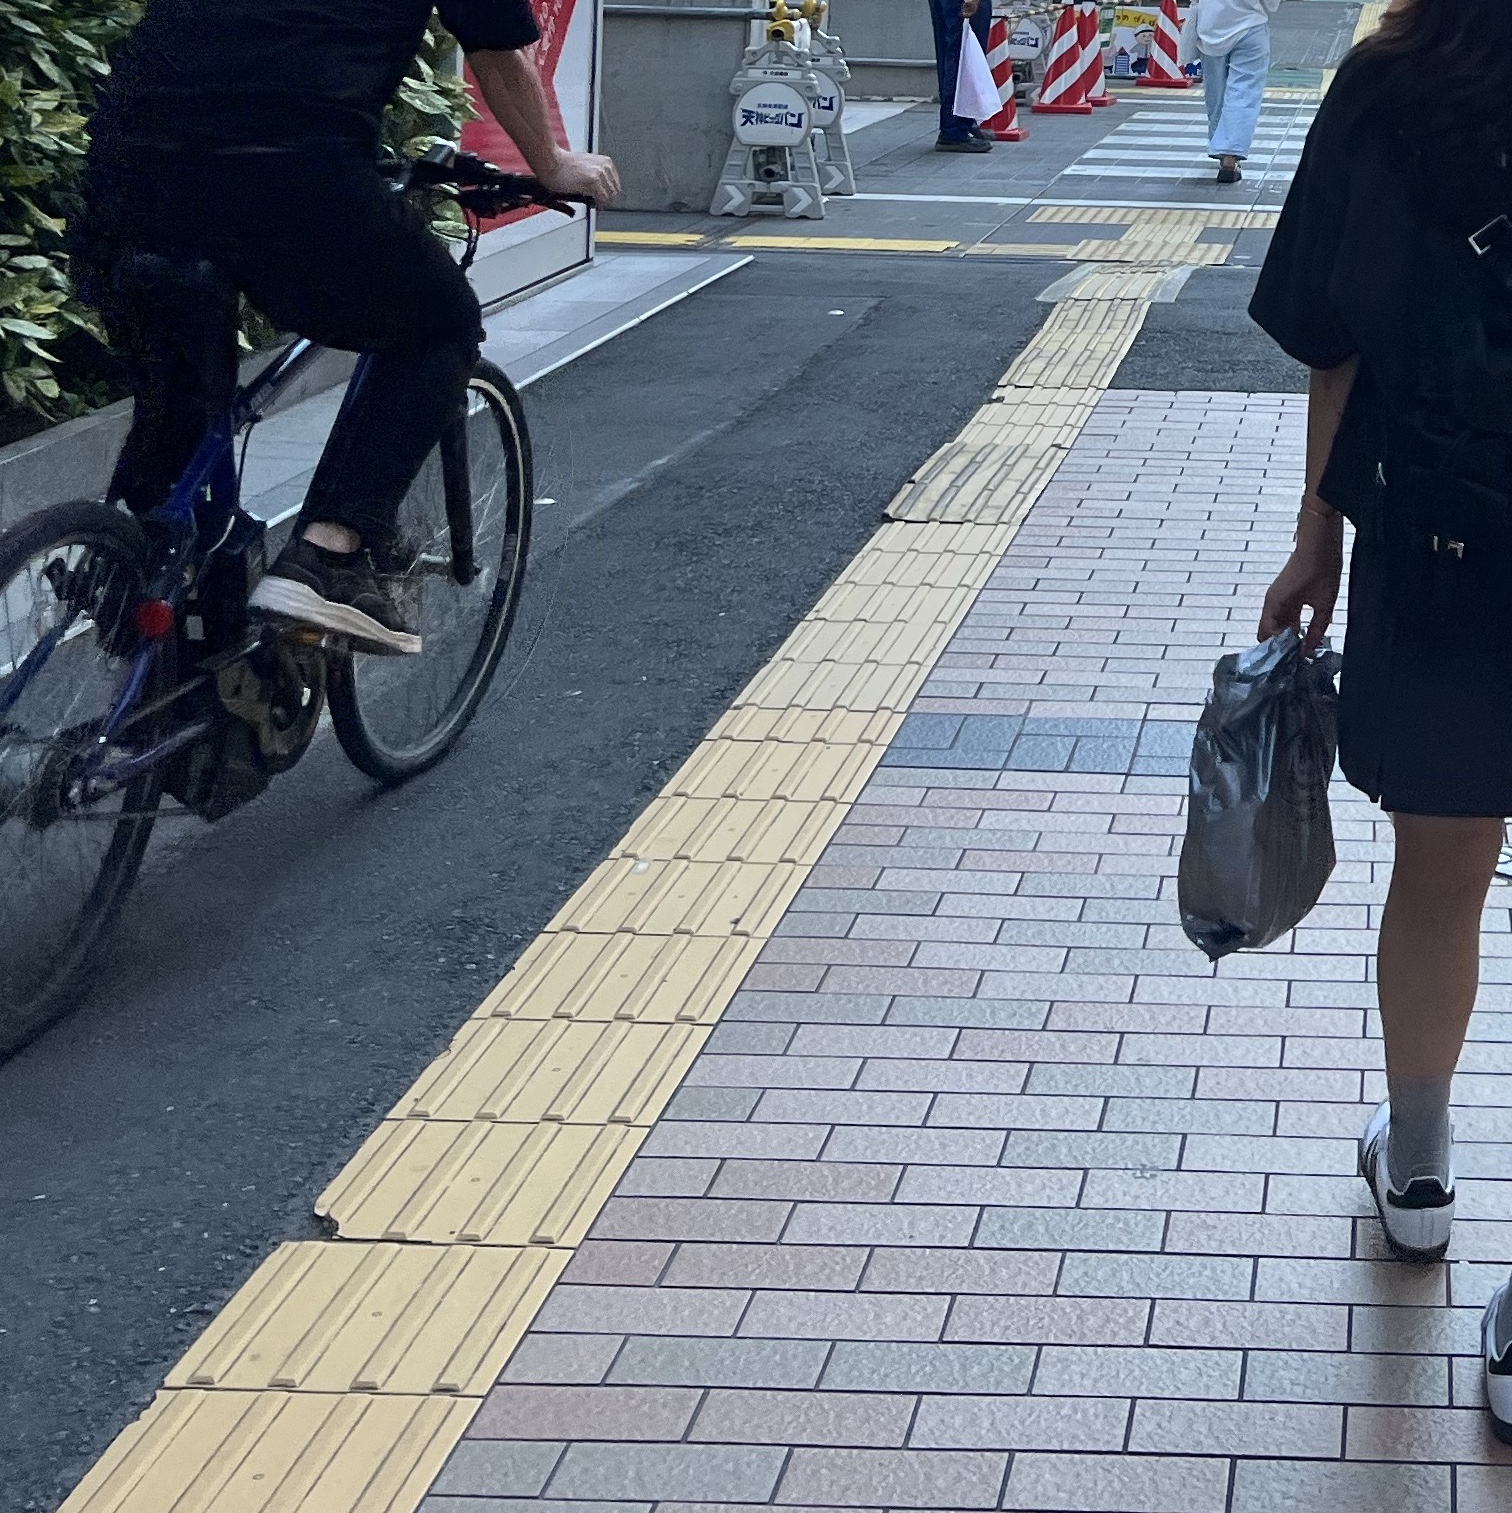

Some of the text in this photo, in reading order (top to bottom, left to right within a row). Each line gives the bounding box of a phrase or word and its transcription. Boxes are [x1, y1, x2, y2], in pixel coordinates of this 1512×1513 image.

[740, 107, 805, 128] 天神ビッグバン
